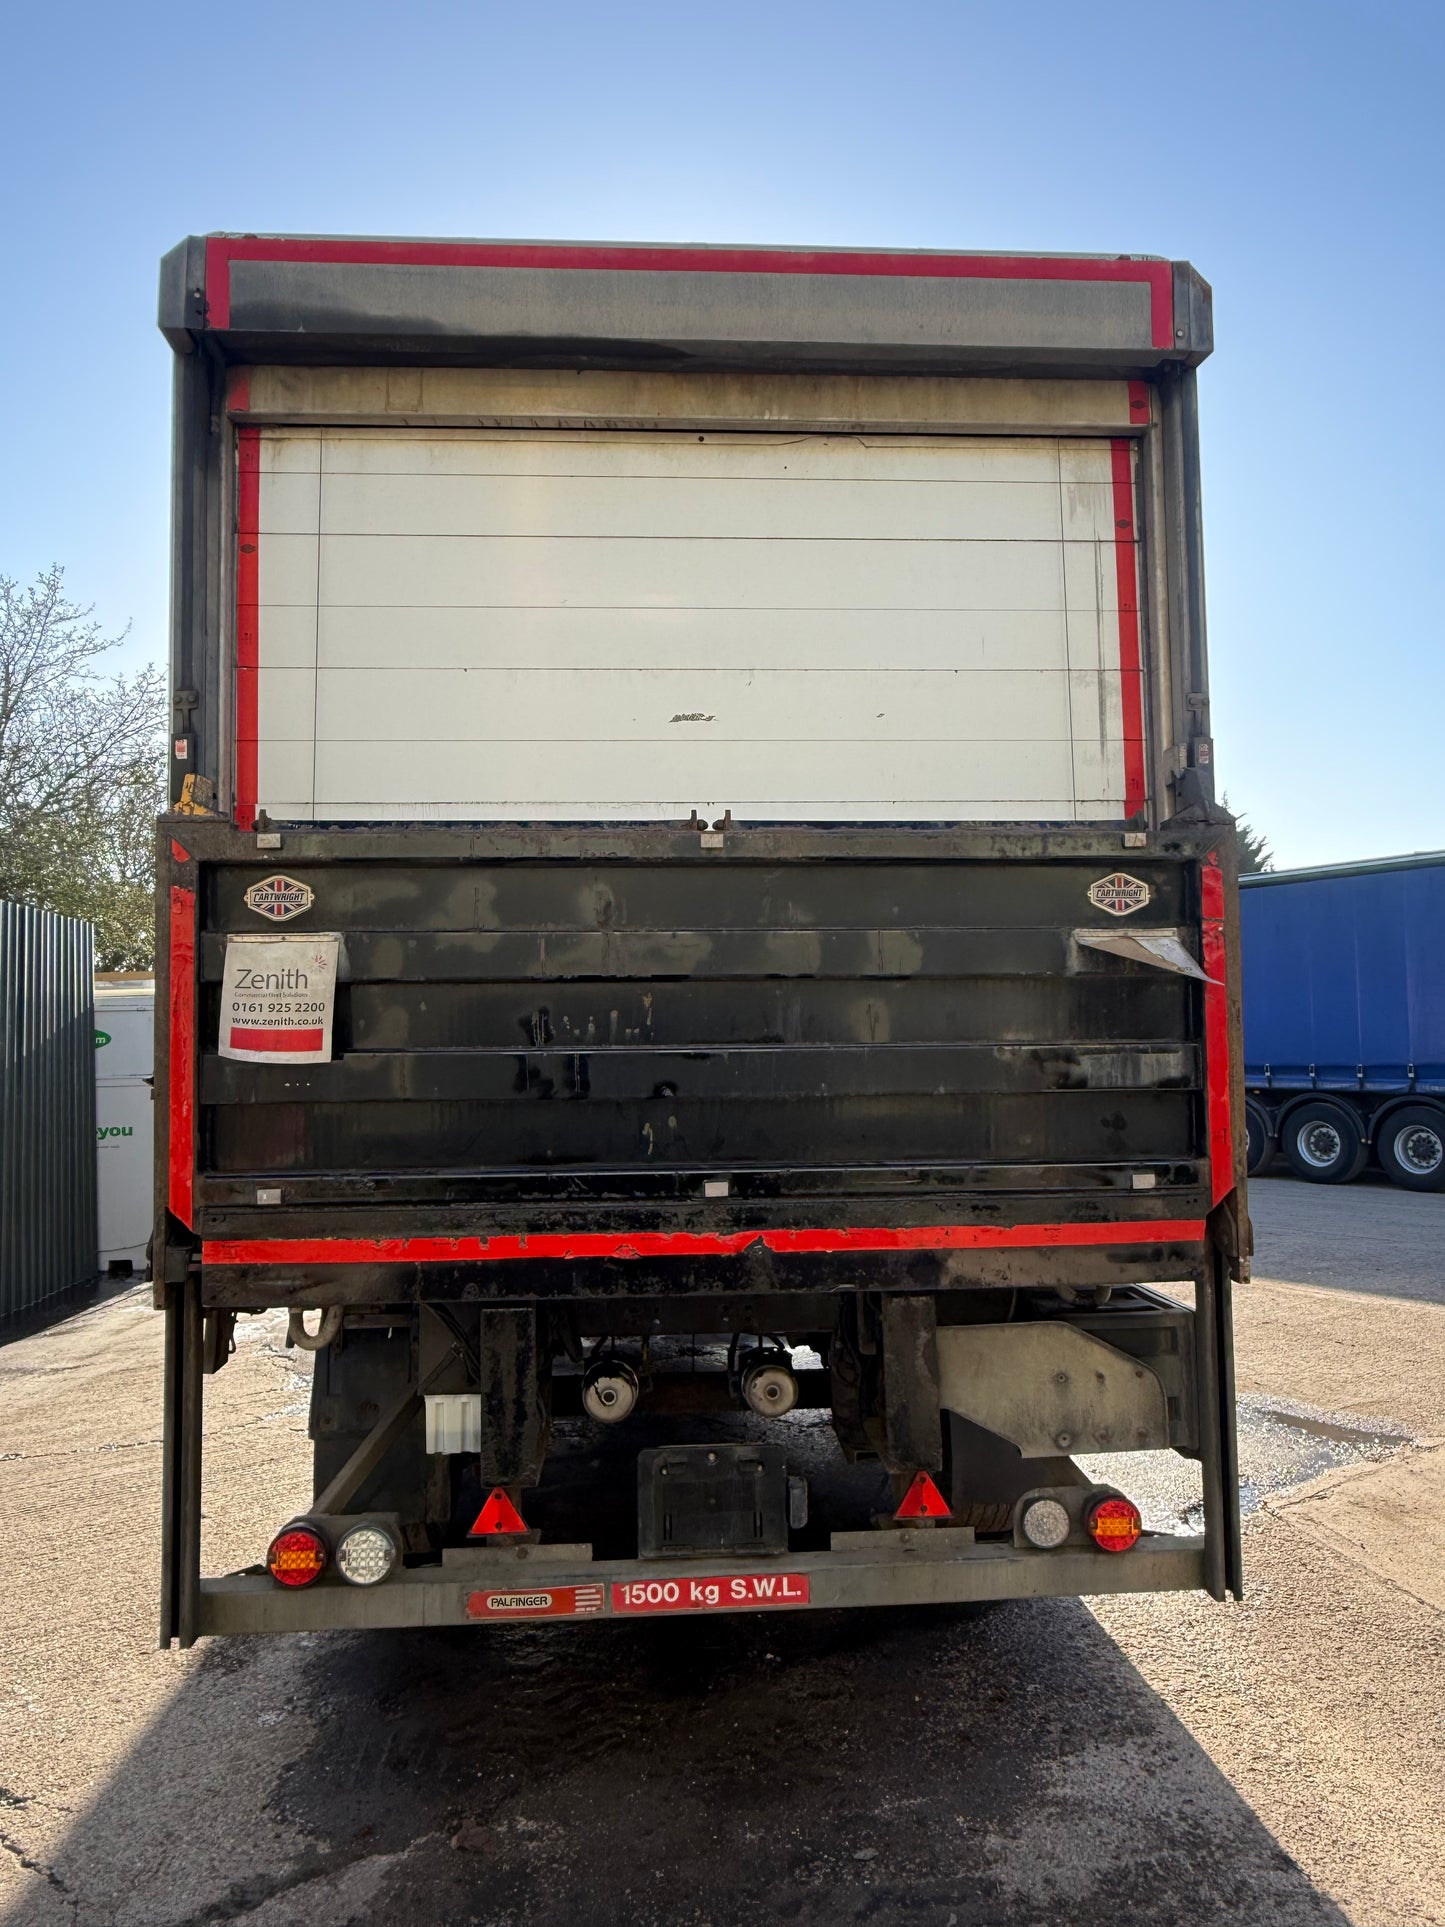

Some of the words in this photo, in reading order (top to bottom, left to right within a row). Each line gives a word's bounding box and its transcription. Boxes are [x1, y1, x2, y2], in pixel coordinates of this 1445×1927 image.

[253, 892, 305, 903] CARTWRIGHT
[1096, 888, 1143, 899] CARTWRIGHT
[234, 968, 308, 990] Zenith
[232, 1002, 263, 1013] 0161
[267, 1002, 292, 1013] 925
[294, 1002, 326, 1013] 2200
[231, 1017, 324, 1026] www.zenith.co.uk
[621, 1582, 680, 1605] 1500
[690, 1581, 719, 1605] kg
[730, 1576, 802, 1599] S.W.L.
[491, 1596, 548, 1607] PALFINGER
